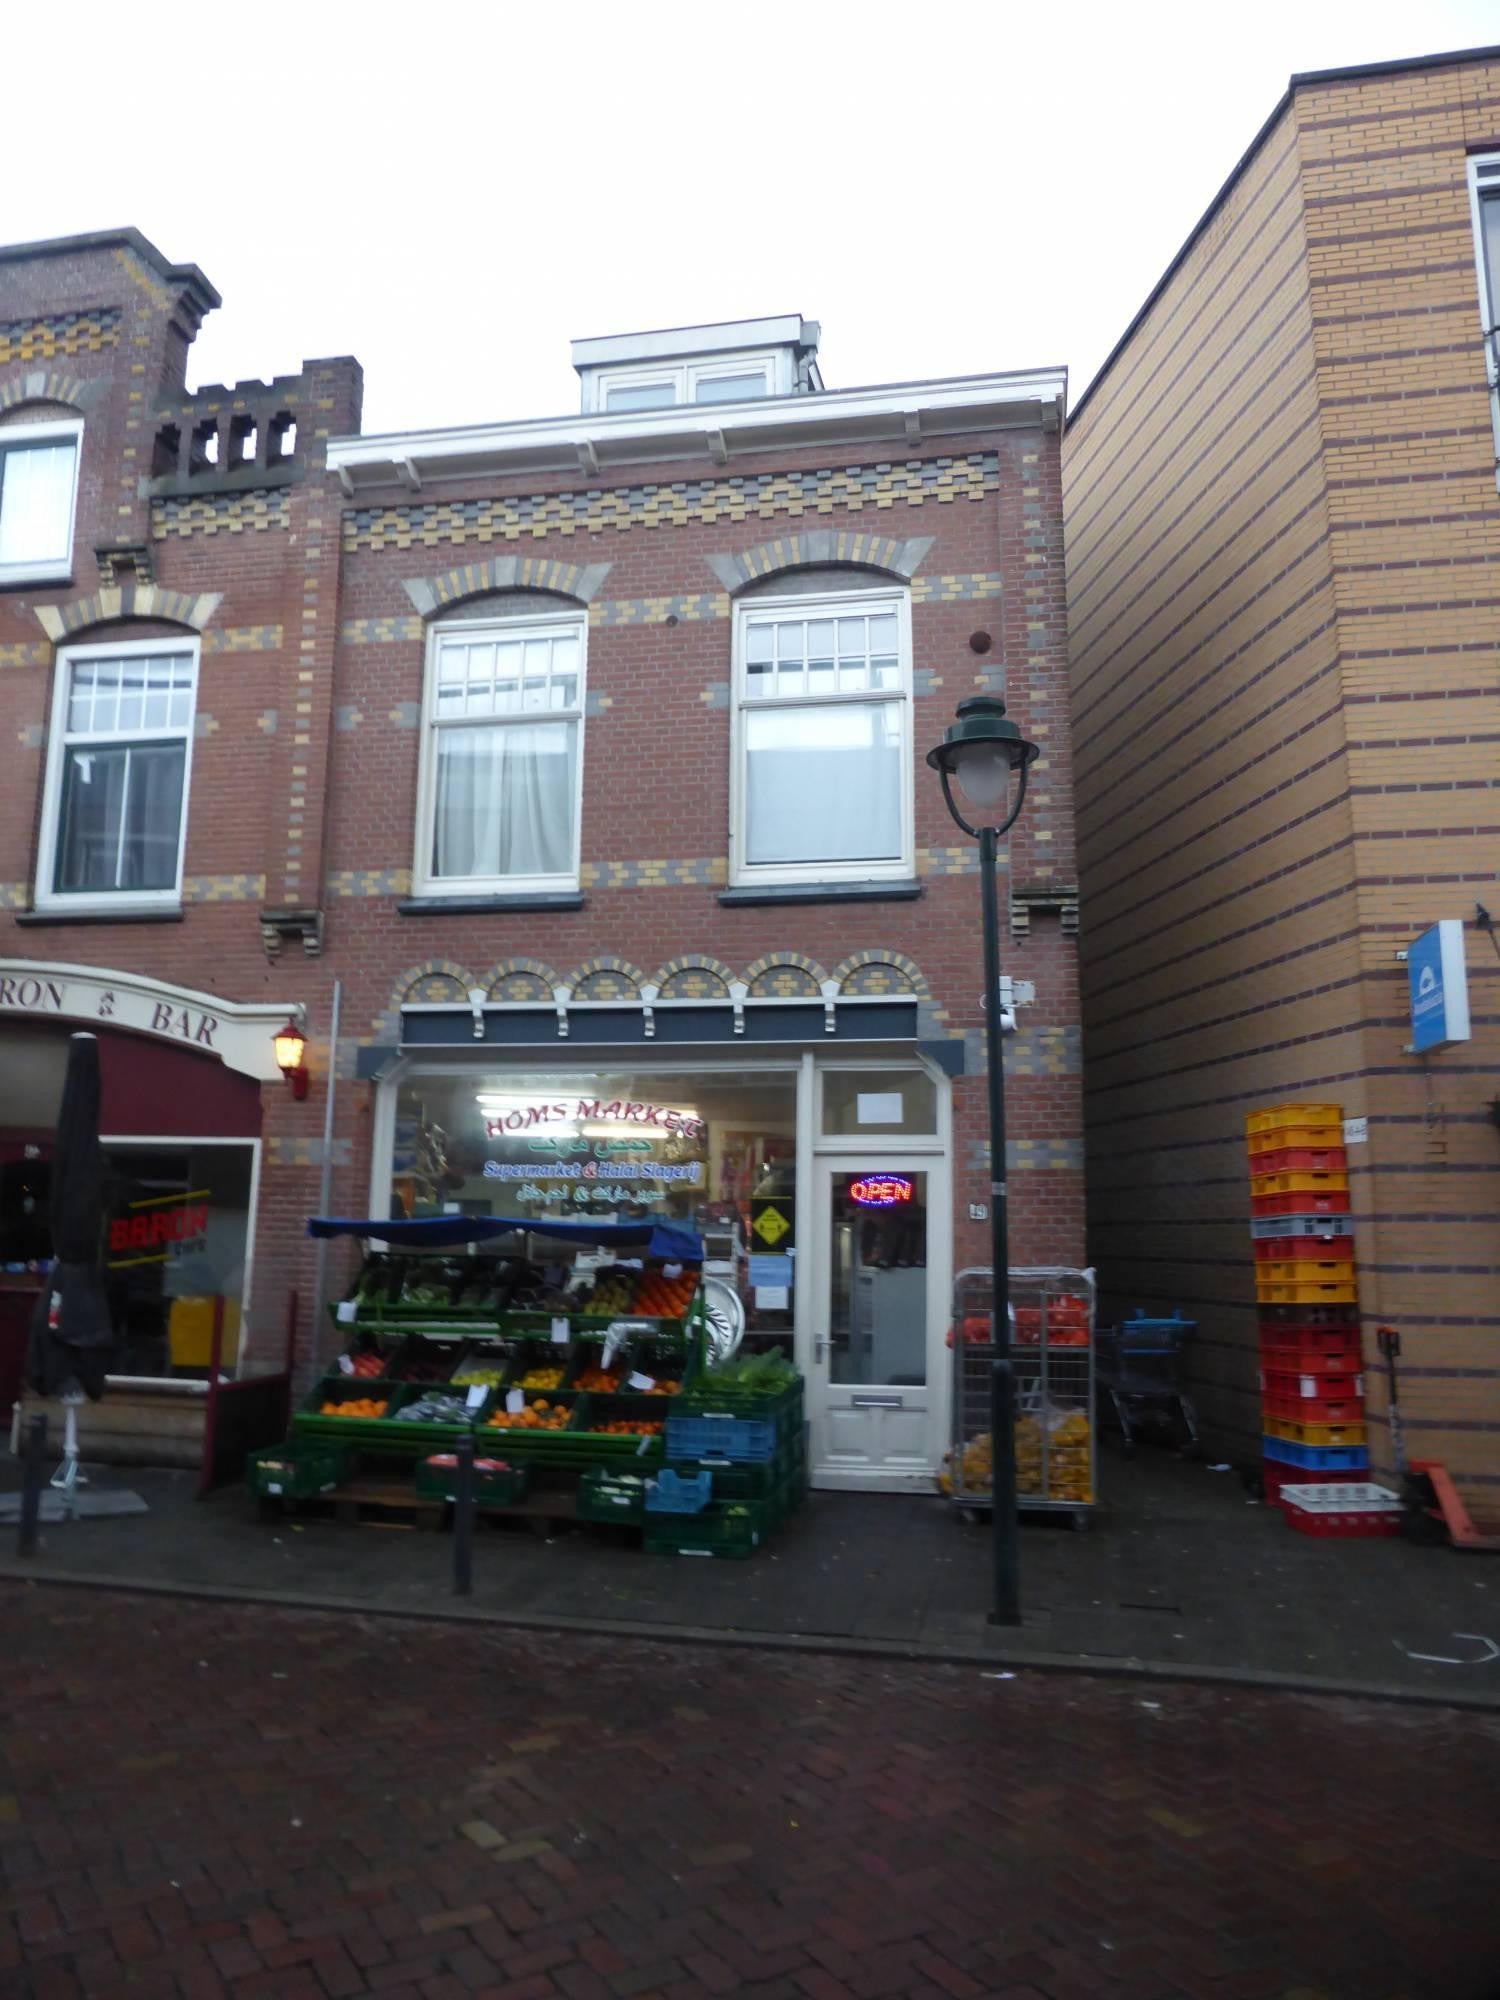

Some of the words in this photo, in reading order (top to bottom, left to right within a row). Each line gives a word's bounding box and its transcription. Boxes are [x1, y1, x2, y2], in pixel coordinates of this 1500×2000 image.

[151, 1002, 218, 1046] BAR
[486, 1103, 569, 1139] HOMS
[576, 1100, 703, 1138] MARKET
[483, 1160, 581, 1182] Supermarket
[582, 1160, 597, 1179] &
[598, 1160, 639, 1178] Halal
[641, 1161, 700, 1183] Slagerij
[851, 1182, 911, 1200] OPEN
[109, 1203, 208, 1251] BARON
